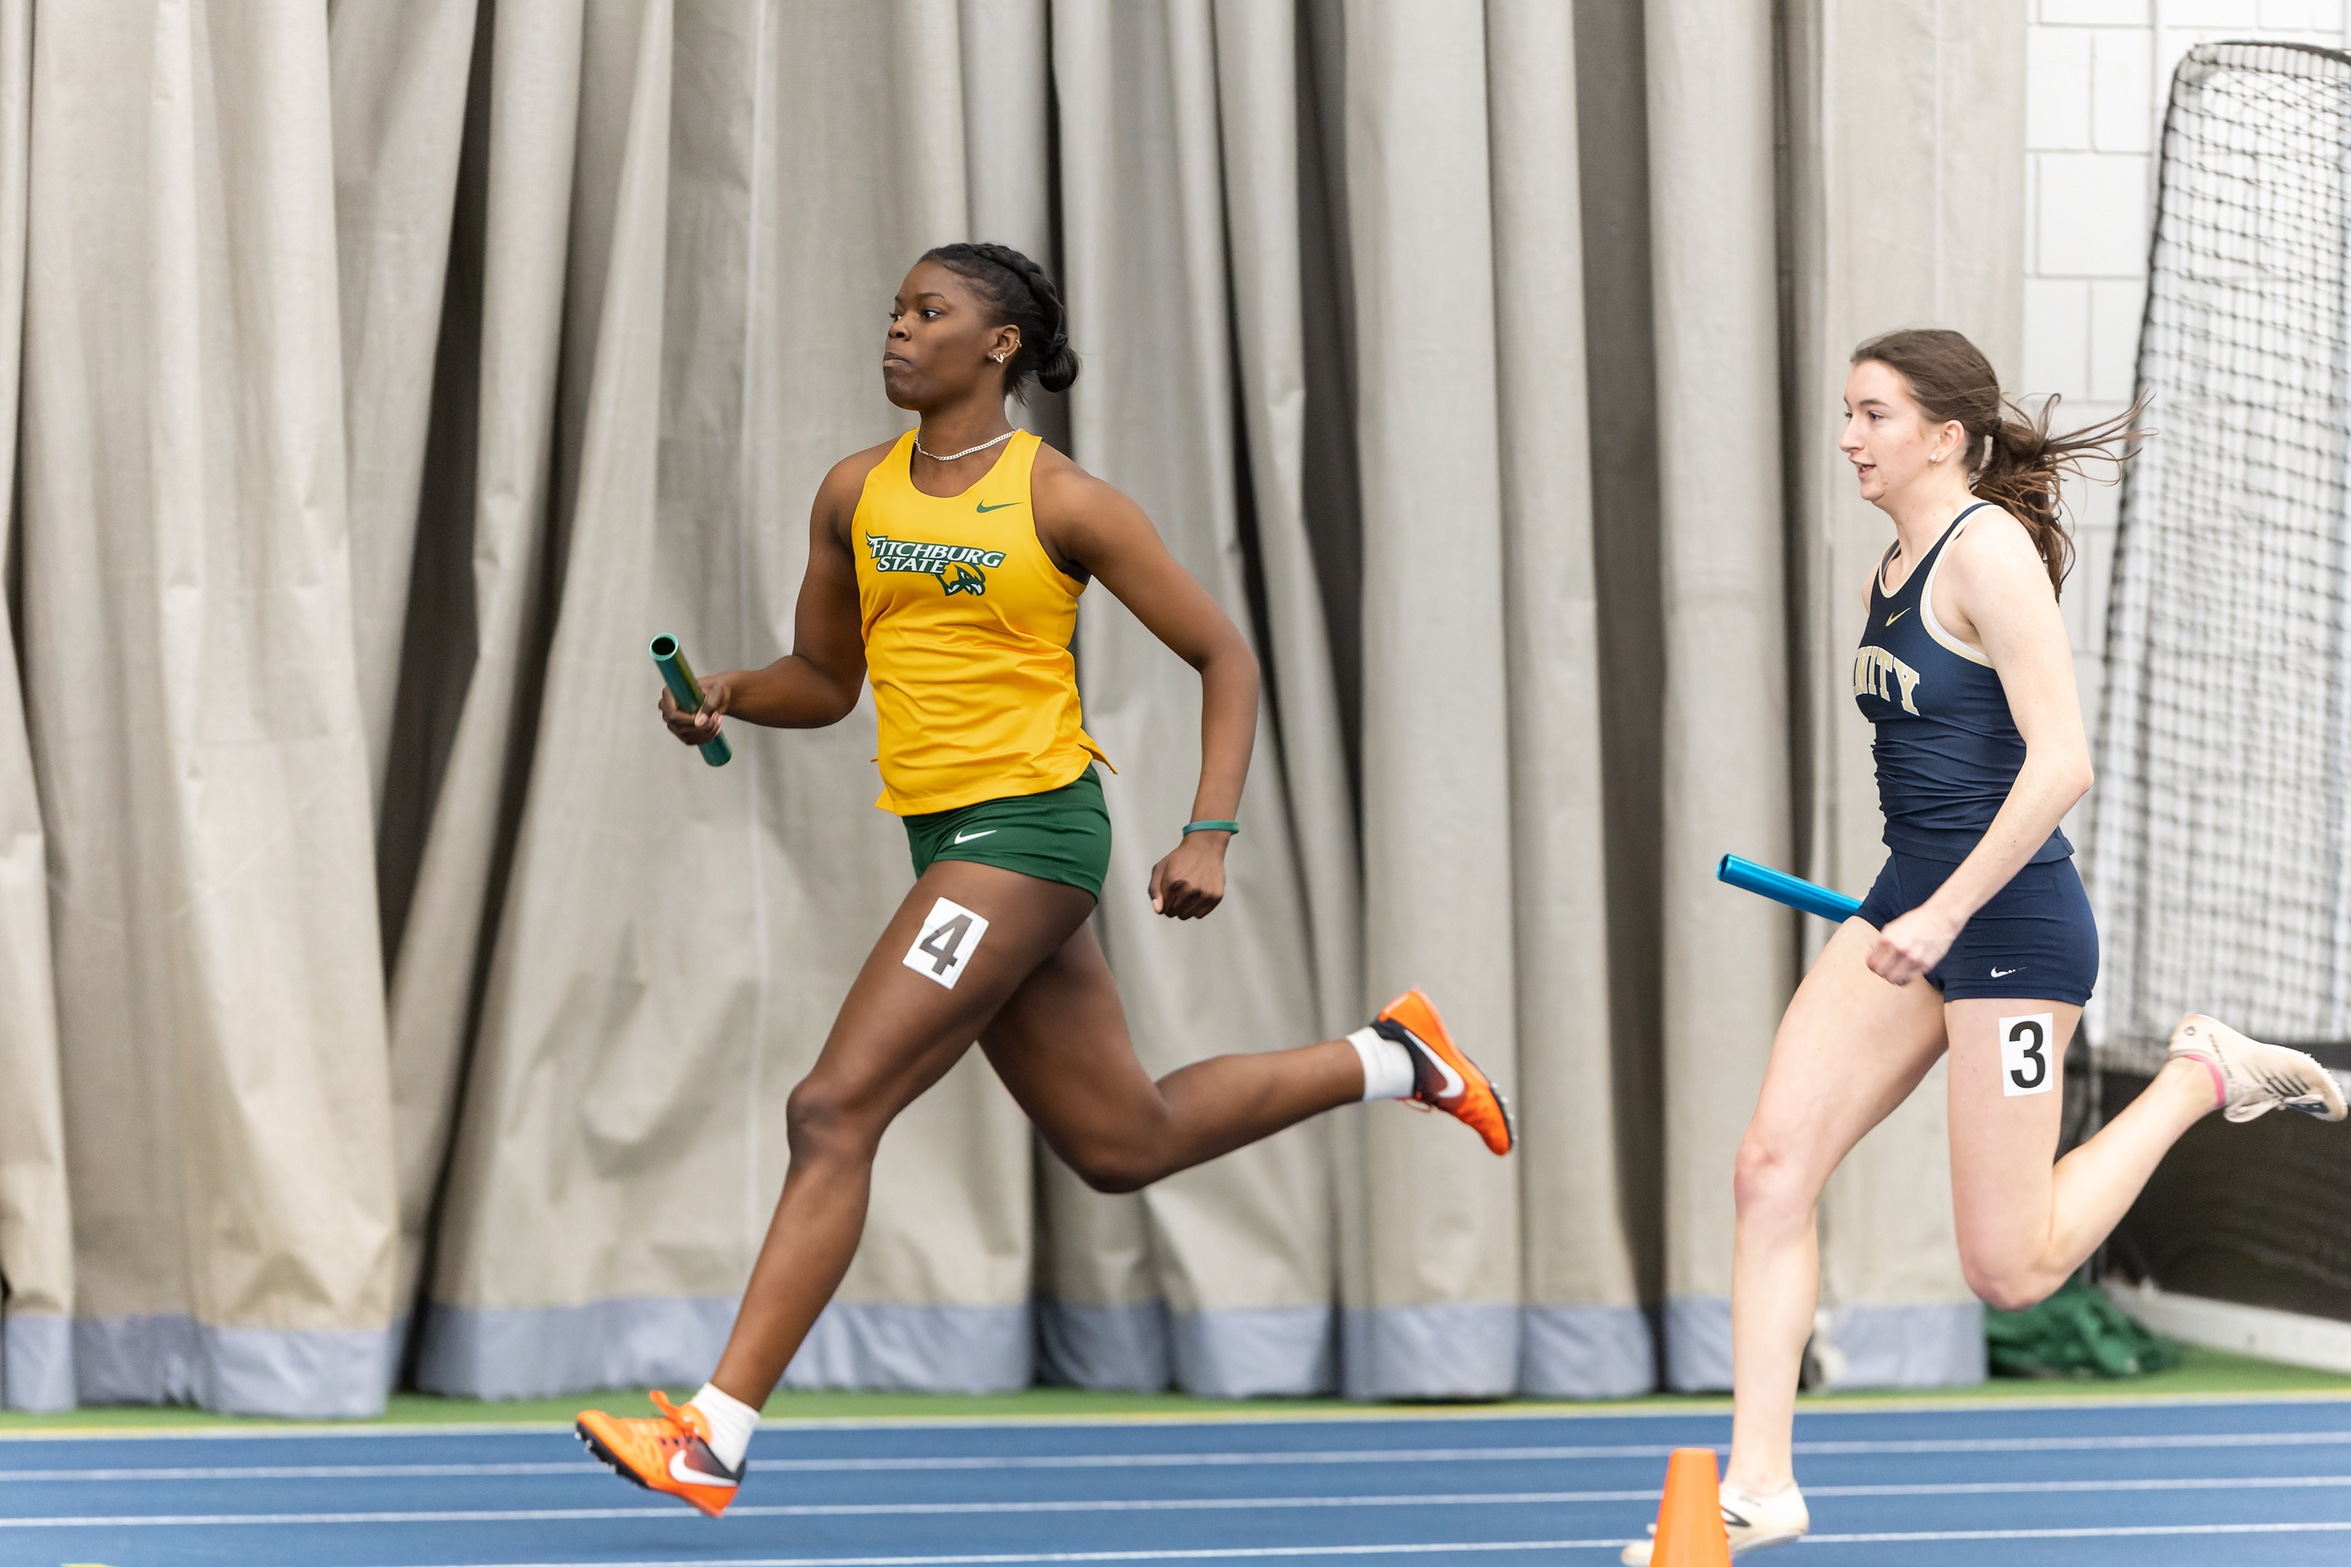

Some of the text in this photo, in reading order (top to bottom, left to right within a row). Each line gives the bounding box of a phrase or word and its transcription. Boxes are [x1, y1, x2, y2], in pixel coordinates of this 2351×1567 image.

[866, 531, 1006, 568] FITCHBURG
[876, 556, 949, 575] STATE
[919, 913, 973, 976] 4
[2009, 1021, 2046, 1089] 3
